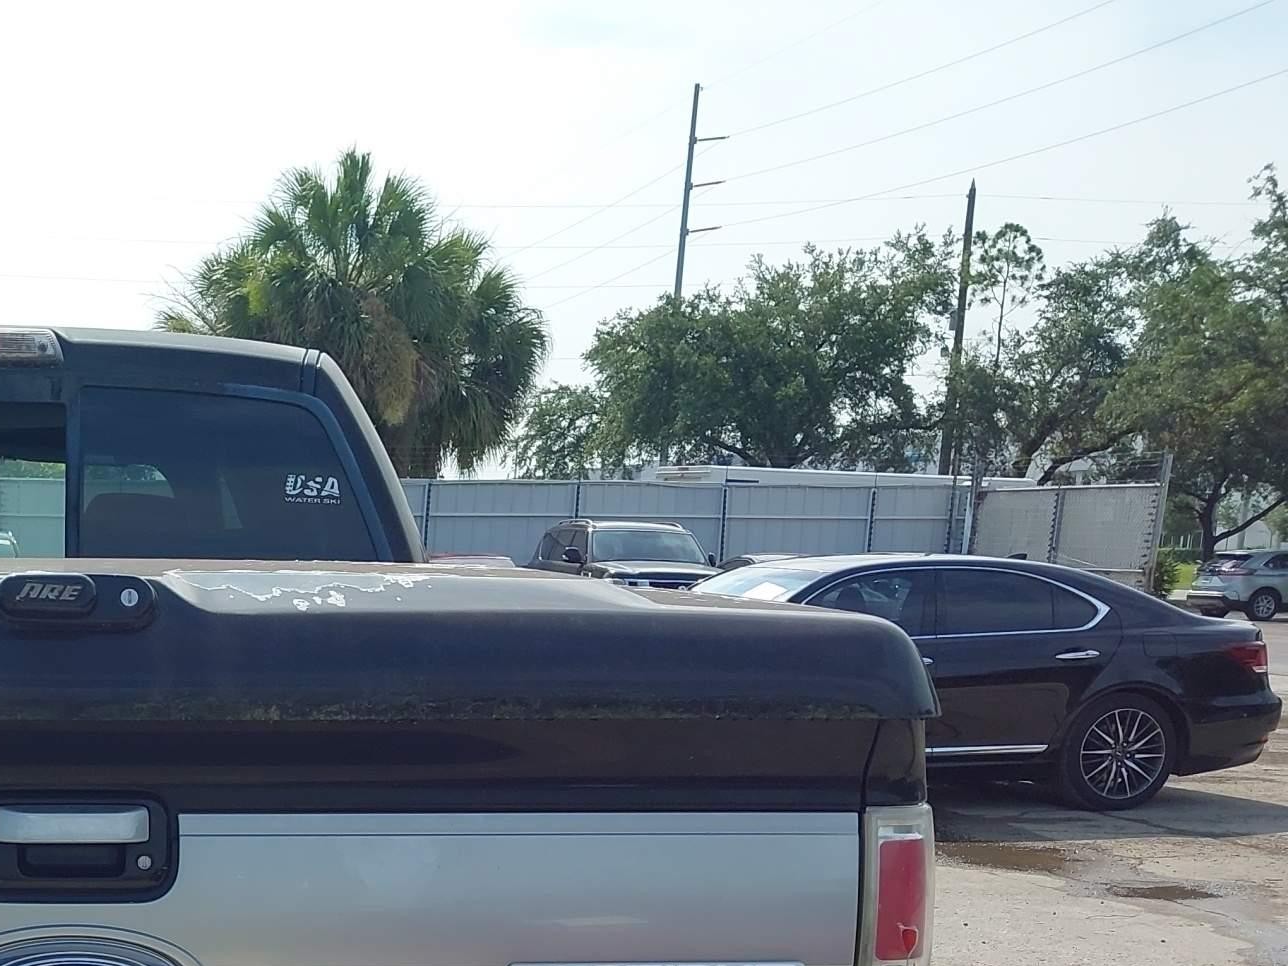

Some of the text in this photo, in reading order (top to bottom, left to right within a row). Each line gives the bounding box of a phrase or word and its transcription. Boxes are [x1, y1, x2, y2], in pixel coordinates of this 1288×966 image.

[285, 474, 340, 497] USA
[284, 496, 321, 504] WATER
[16, 583, 83, 601] ARE
